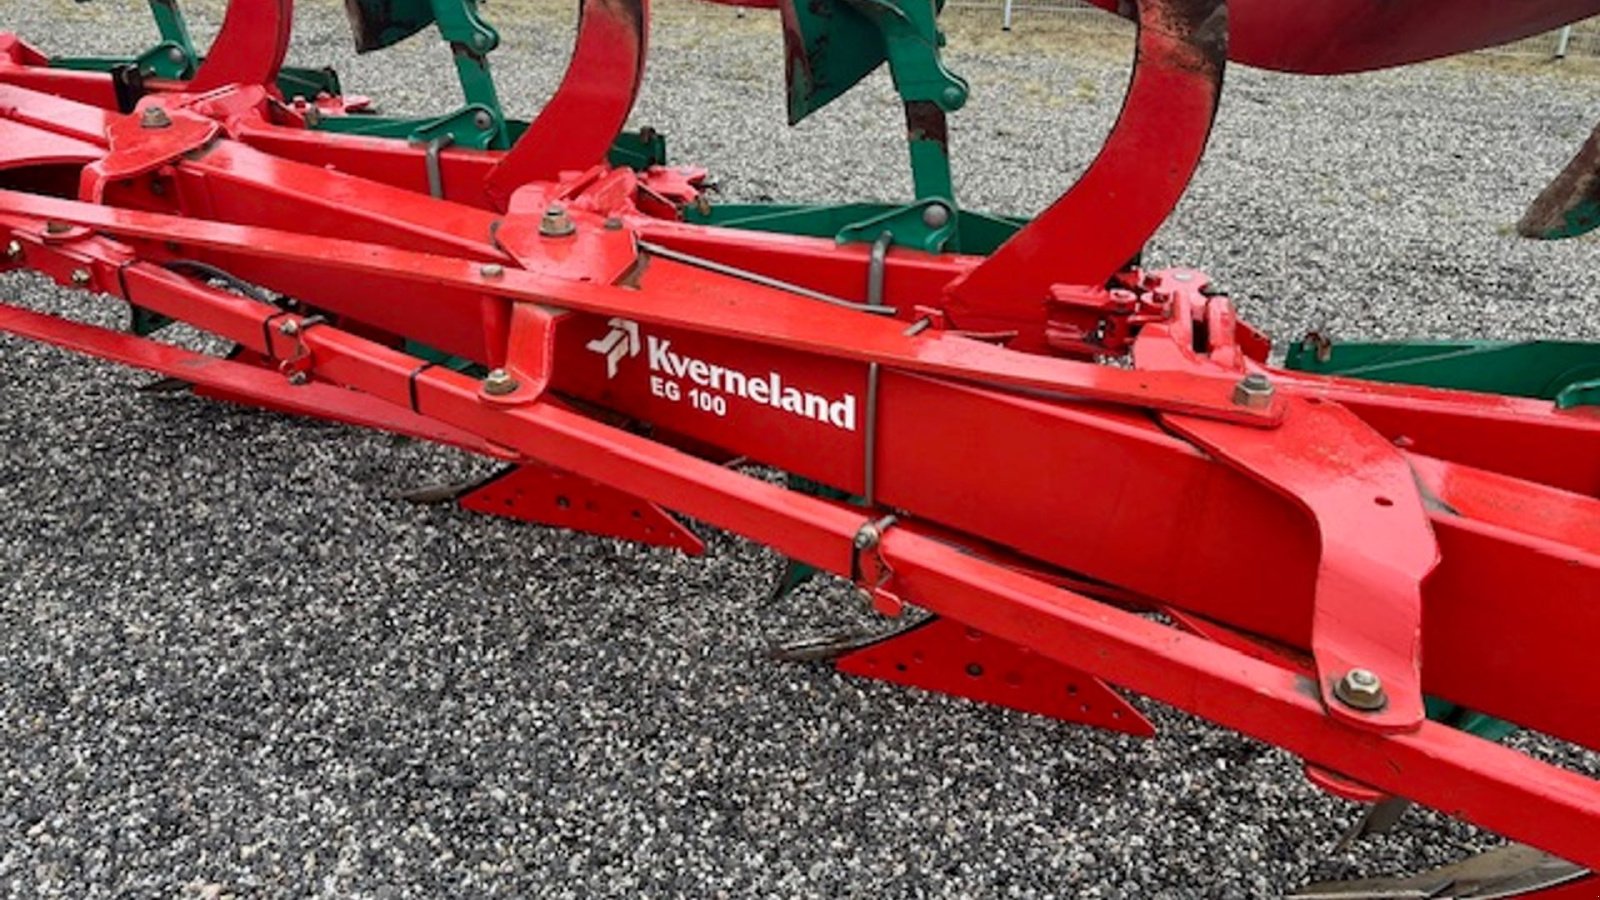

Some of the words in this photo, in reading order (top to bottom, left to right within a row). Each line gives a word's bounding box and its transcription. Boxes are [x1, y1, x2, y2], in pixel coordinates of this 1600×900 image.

[648, 335, 856, 431] Kverneland
[650, 376, 681, 401] EG
[689, 390, 726, 416] 100
